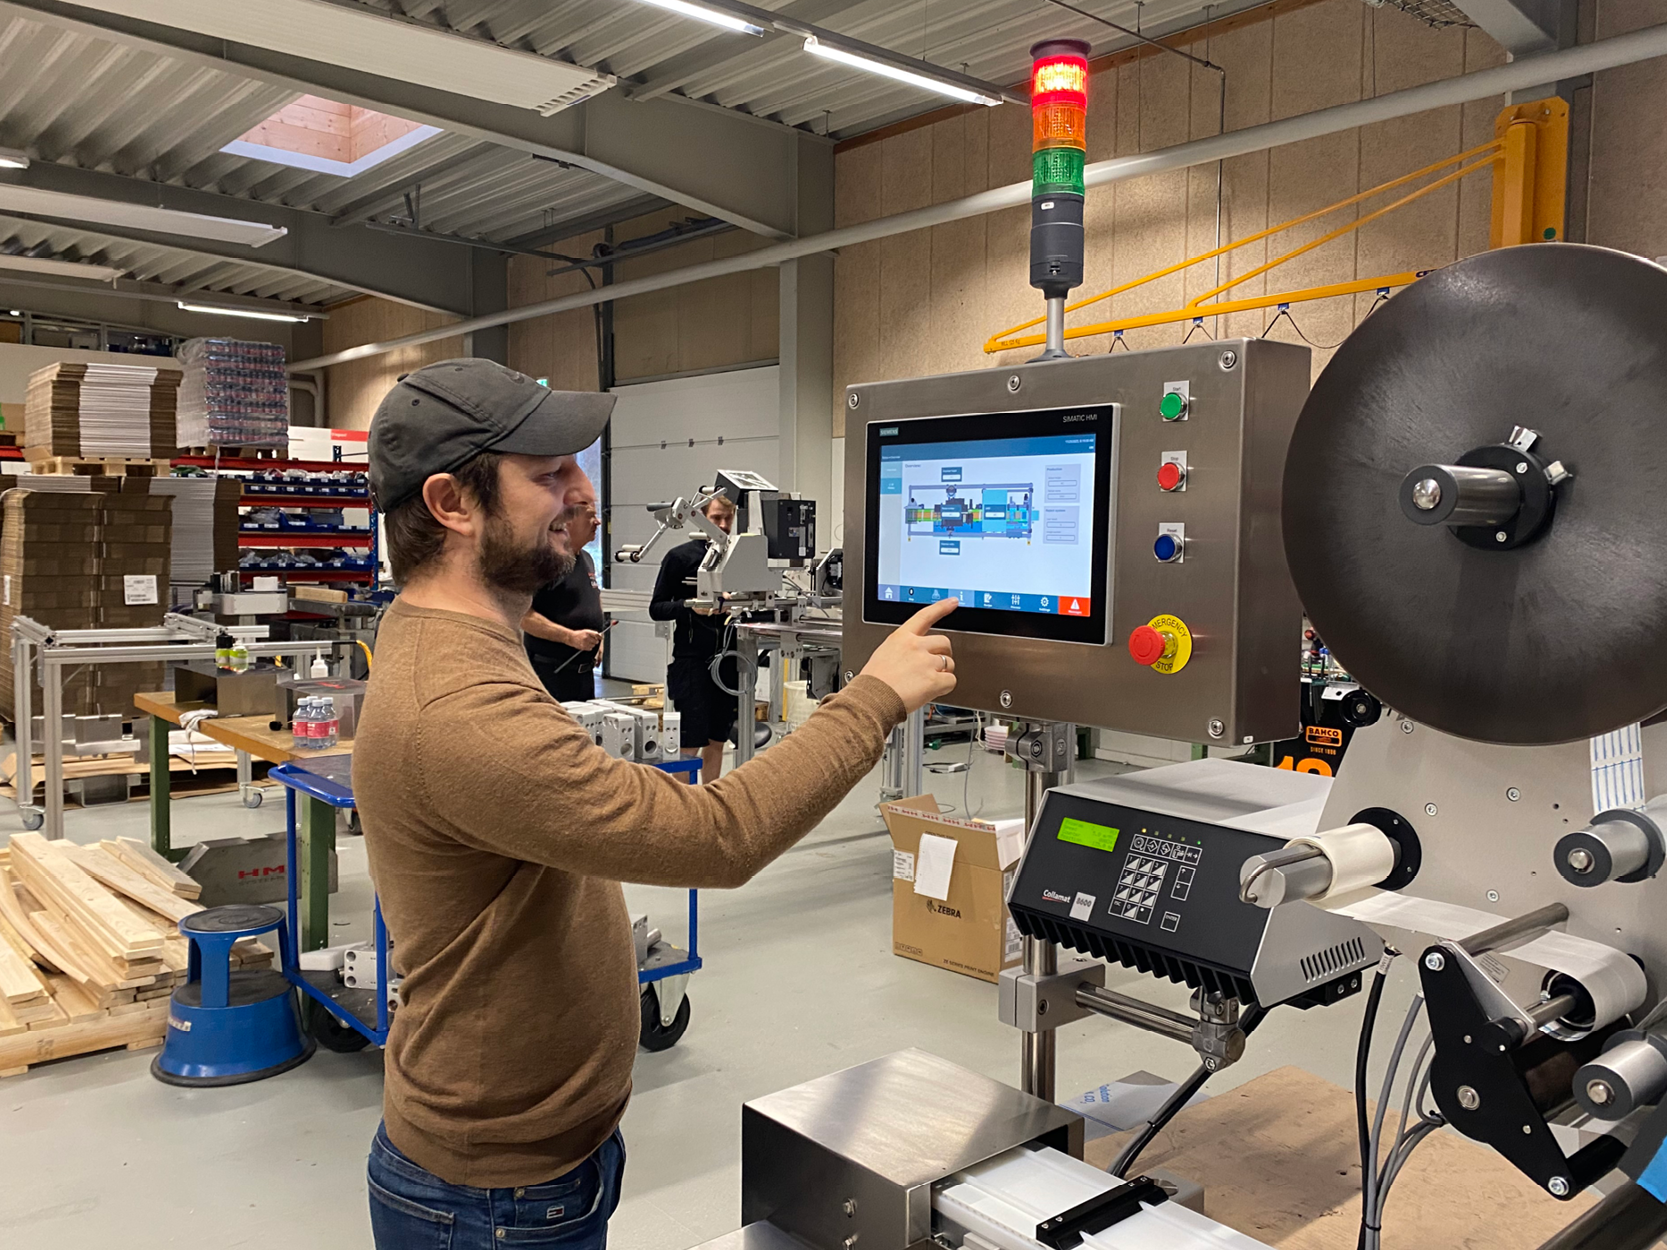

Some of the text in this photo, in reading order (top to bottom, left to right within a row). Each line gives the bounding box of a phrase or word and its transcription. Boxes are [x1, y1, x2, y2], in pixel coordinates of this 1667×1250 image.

[1063, 414, 1085, 423] SIMATIC
[1151, 617, 1188, 638] MERGENCY
[1155, 660, 1174, 672] STOP
[1308, 727, 1339, 737] BAHCO
[238, 865, 285, 879] HM
[1043, 889, 1071, 904] Collamat
[937, 904, 962, 919] ZEBRA
[964, 964, 977, 972] PRINT
[977, 967, 995, 977] ENGINE
